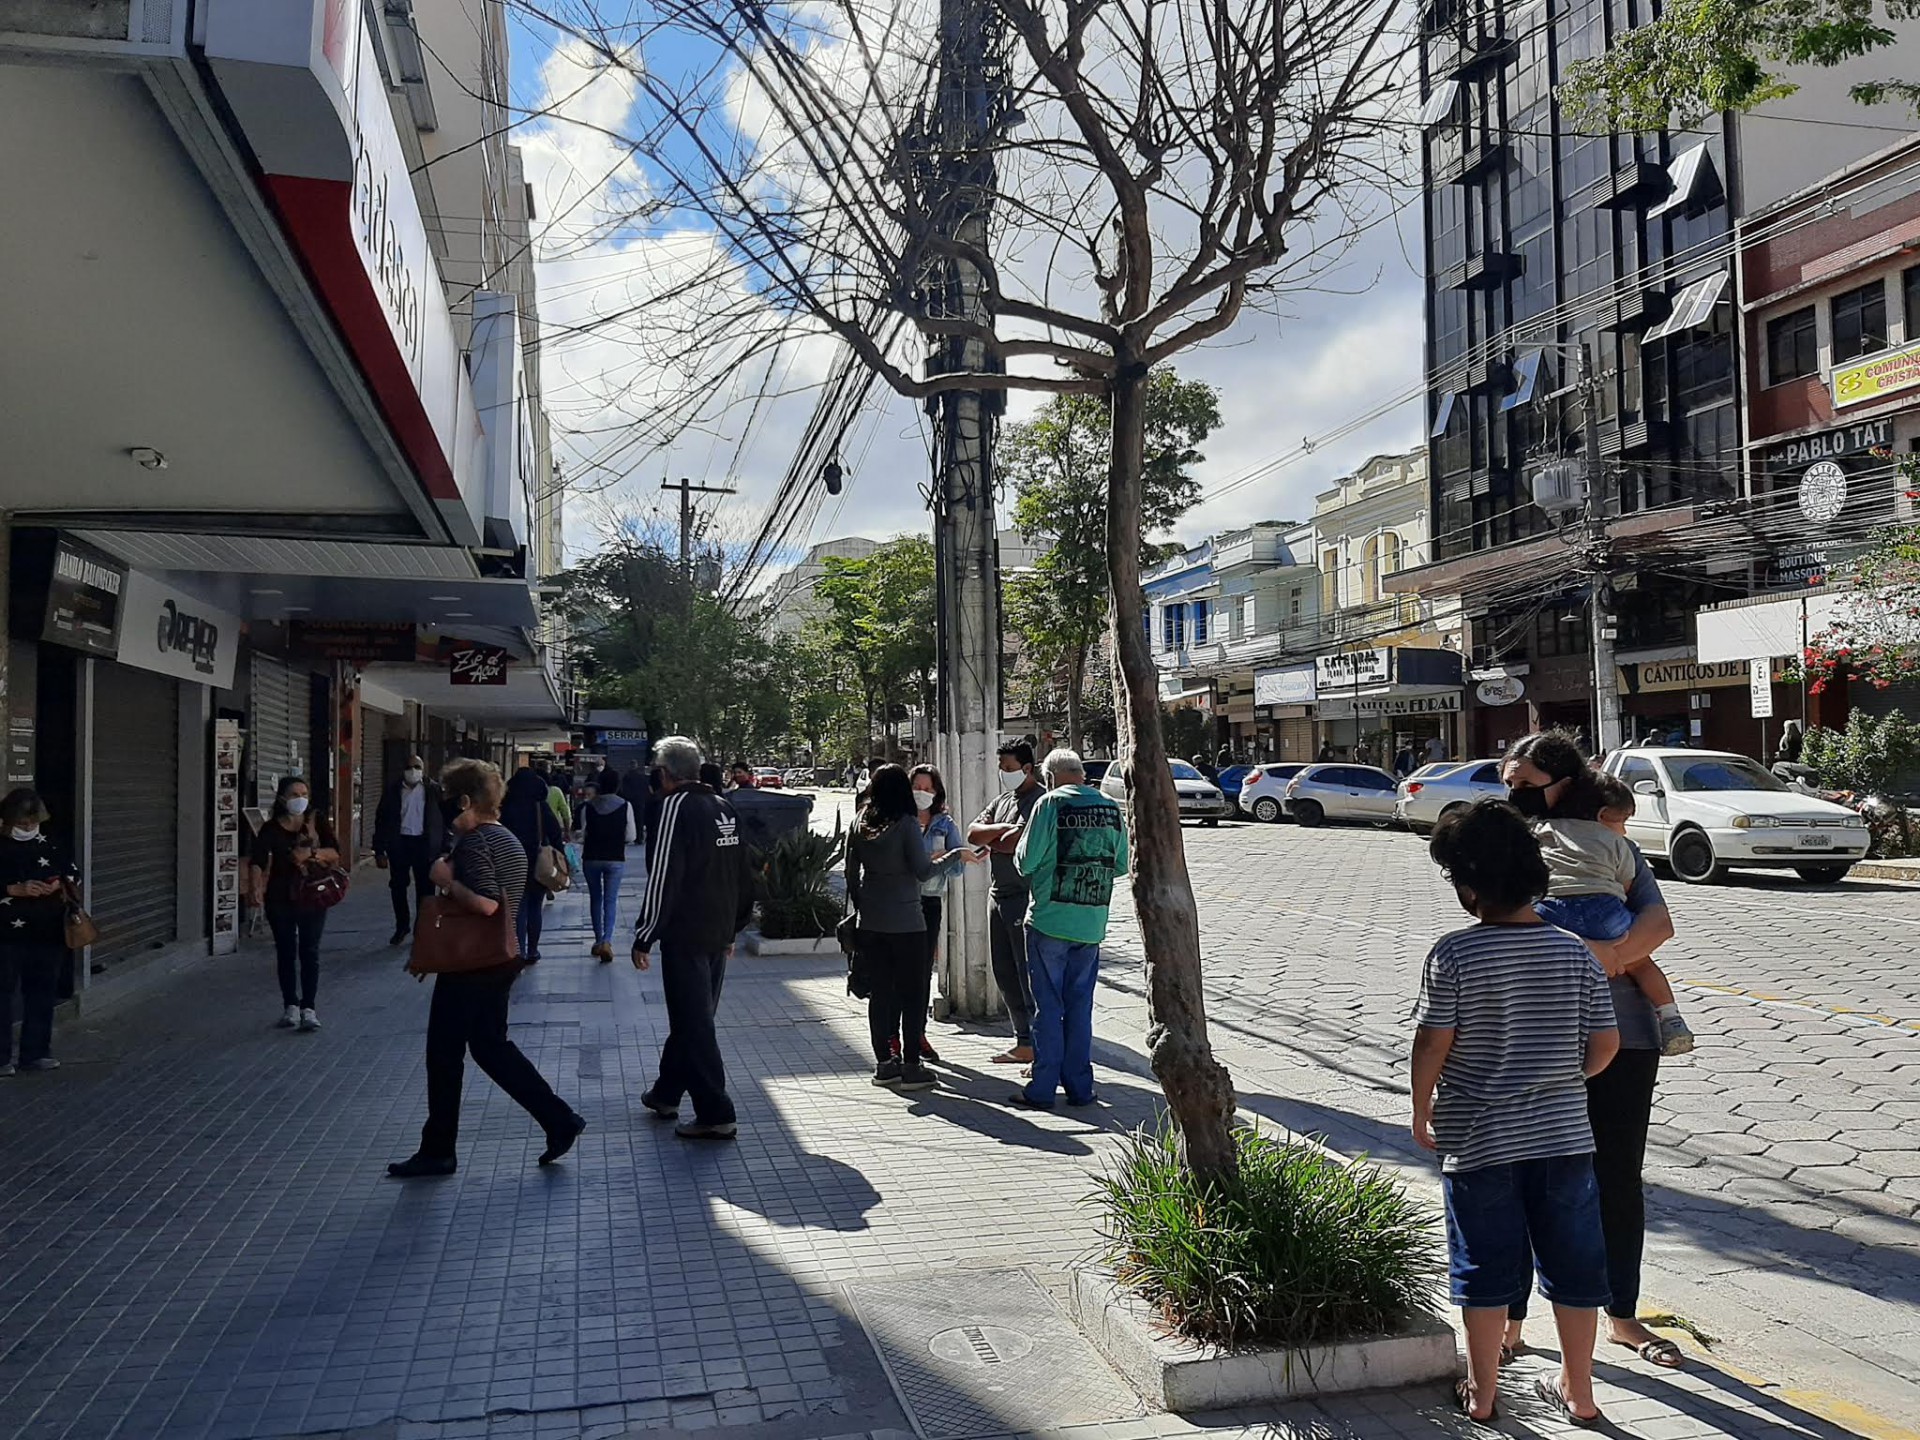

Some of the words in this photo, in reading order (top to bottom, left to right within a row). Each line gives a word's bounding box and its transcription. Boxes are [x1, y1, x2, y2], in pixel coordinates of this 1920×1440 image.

[354, 119, 417, 362] radesco
[1865, 353, 1920, 378] COMUNI
[1787, 431, 1845, 465] PABLO
[1850, 418, 1892, 449] TAT
[1779, 551, 1827, 569] BOUTIQUE
[1644, 663, 1714, 684] CÂNTICOS
[1718, 661, 1739, 678] DE
[608, 731, 647, 740] SERRAL
[1056, 813, 1109, 829] COBRA
